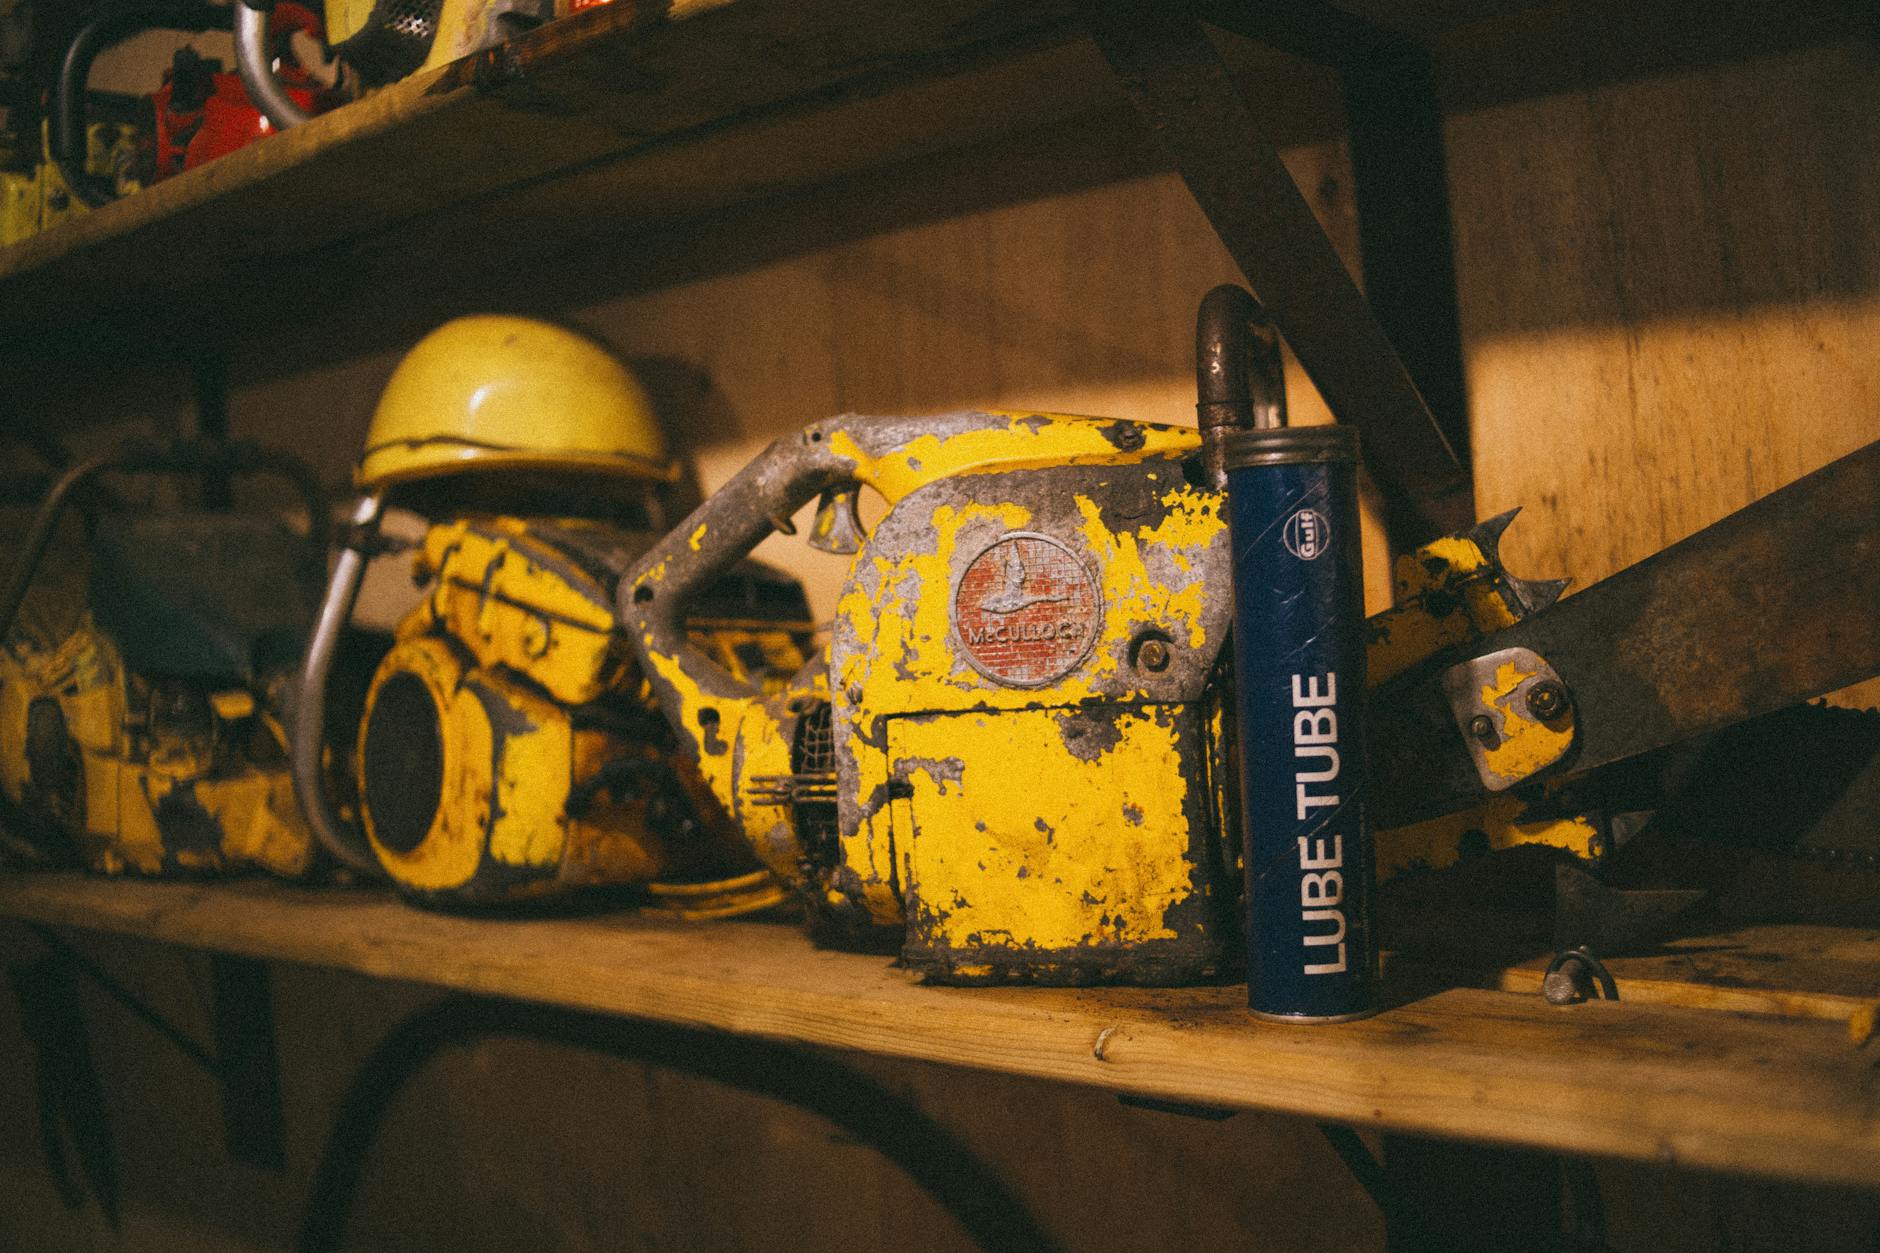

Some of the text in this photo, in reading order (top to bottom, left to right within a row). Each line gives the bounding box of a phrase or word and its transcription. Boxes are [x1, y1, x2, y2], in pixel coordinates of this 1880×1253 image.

[1300, 513, 1315, 558] Gulf
[968, 623, 1086, 645] McCULLOCH
[1292, 672, 1347, 976] LUBE TUBE
